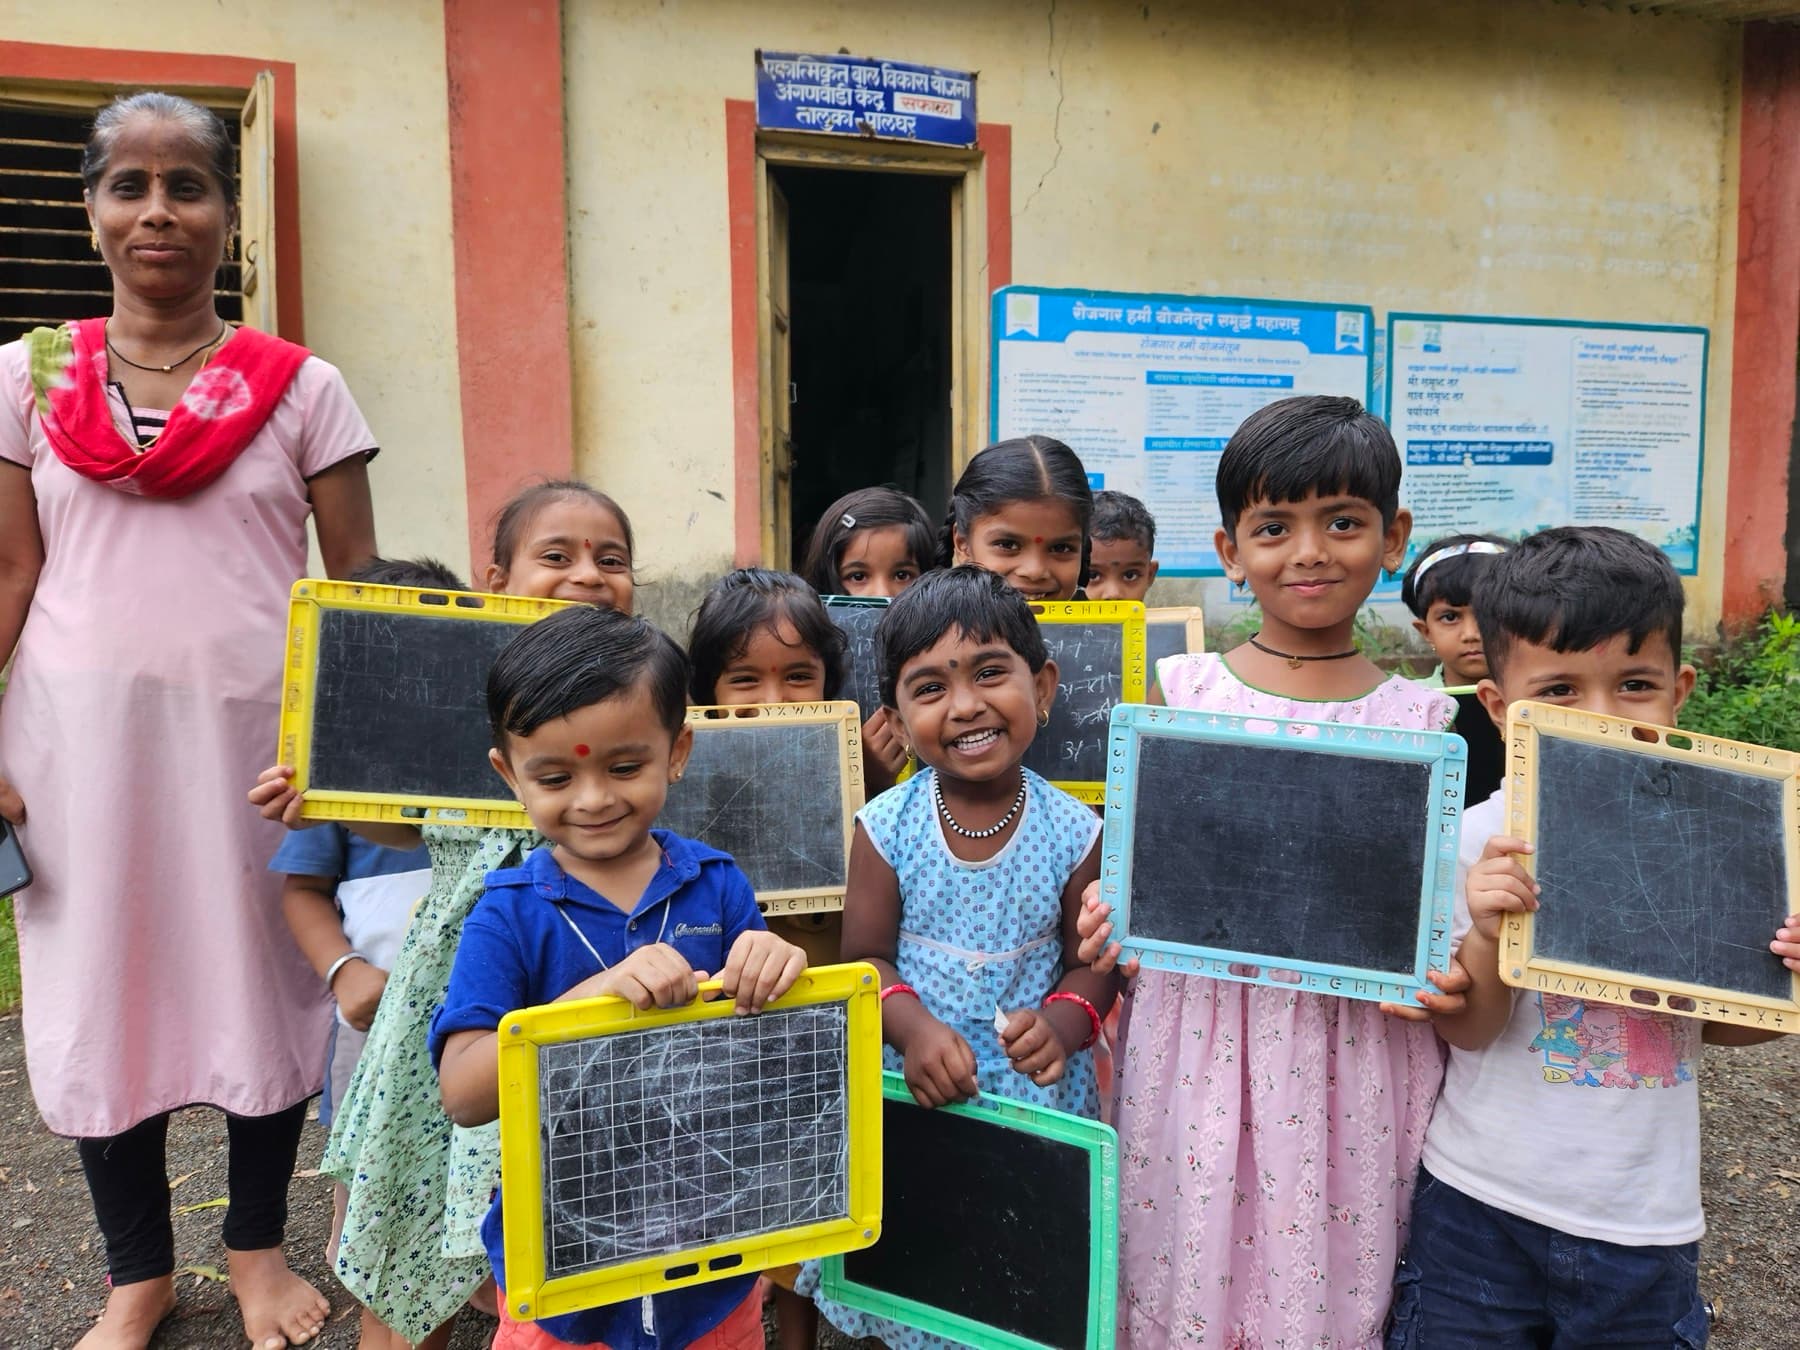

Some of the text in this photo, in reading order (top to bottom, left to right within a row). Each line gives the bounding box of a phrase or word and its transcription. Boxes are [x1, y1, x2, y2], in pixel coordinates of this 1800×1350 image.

[881, 62, 929, 92] विकास
[1072, 302, 1122, 322] रोजगार
[1126, 304, 1151, 325] हमी
[1156, 306, 1213, 330] योजनेतून
